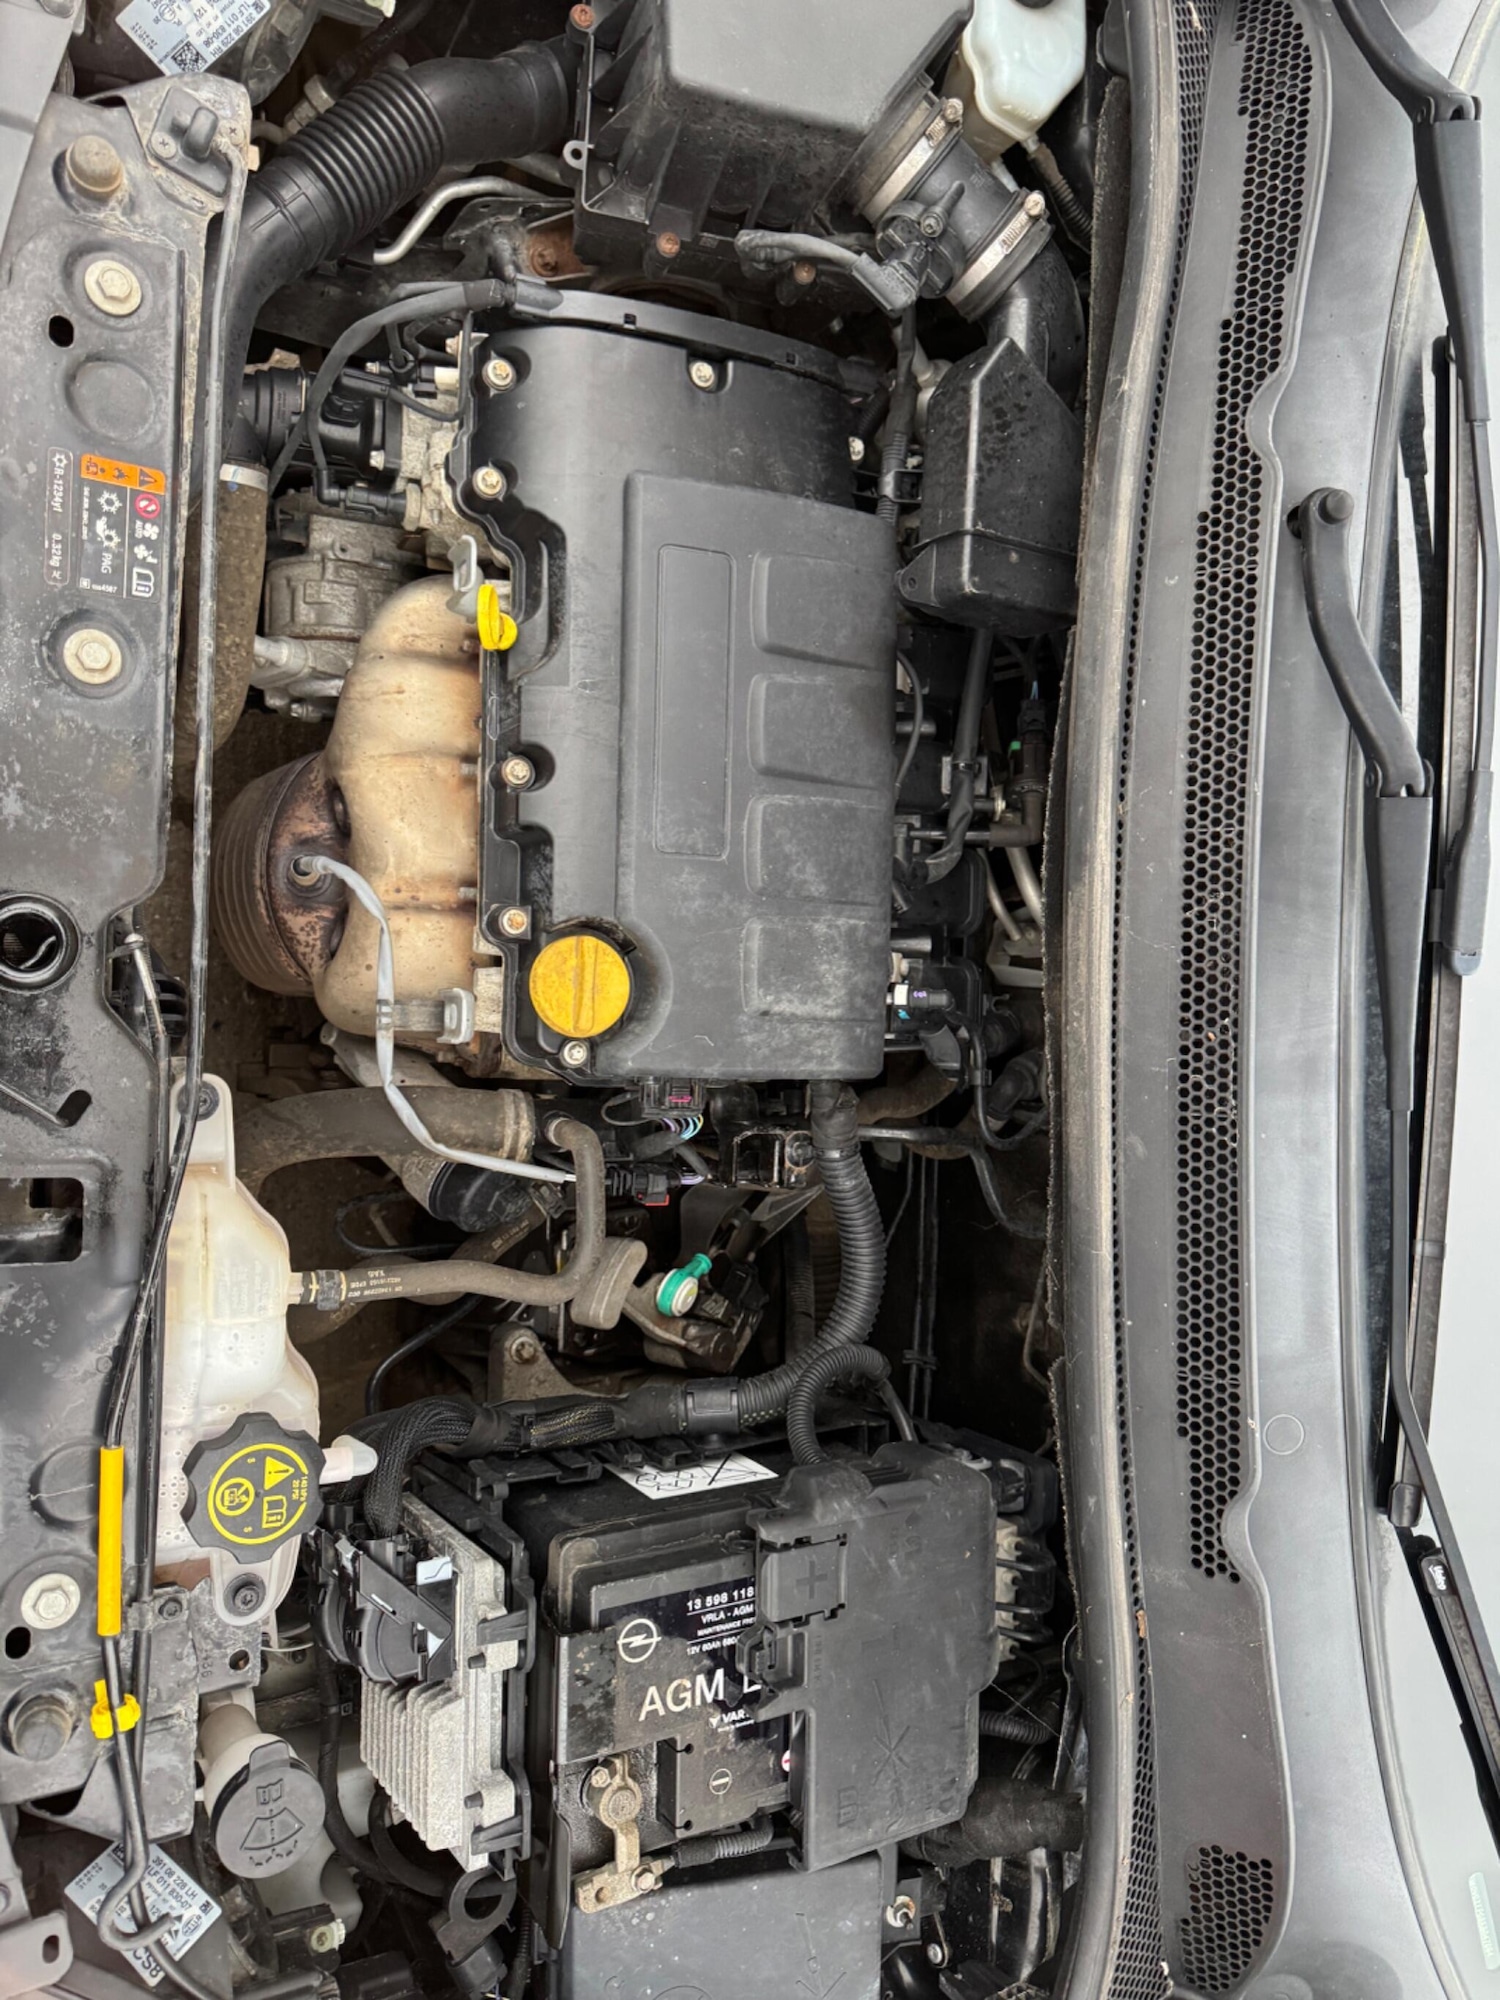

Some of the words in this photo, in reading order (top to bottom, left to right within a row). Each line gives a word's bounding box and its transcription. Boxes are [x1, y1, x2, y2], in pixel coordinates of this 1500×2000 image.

[193, 6, 208, 22] 12V
[225, 13, 240, 28] 011
[210, 44, 223, 58] RH
[51, 467, 64, 513] R-1234yf
[101, 552, 113, 574] PAG
[686, 1599, 702, 1612] 13
[705, 1592, 728, 1605] 598
[732, 1586, 755, 1601] 118
[701, 1611, 726, 1625] VRLA
[733, 1603, 754, 1617] AGM
[697, 1621, 741, 1637] MAINTENANCE
[742, 1617, 757, 1626] FRE
[686, 1644, 700, 1656] 12V
[638, 1668, 725, 1722] AGM
[722, 1710, 751, 1723] VAR
[152, 1855, 166, 1870] 391
[164, 1867, 176, 1879] 08
[184, 1887, 198, 1900] LH
[156, 1876, 171, 1890] 011
[133, 1946, 164, 1978] CS8
